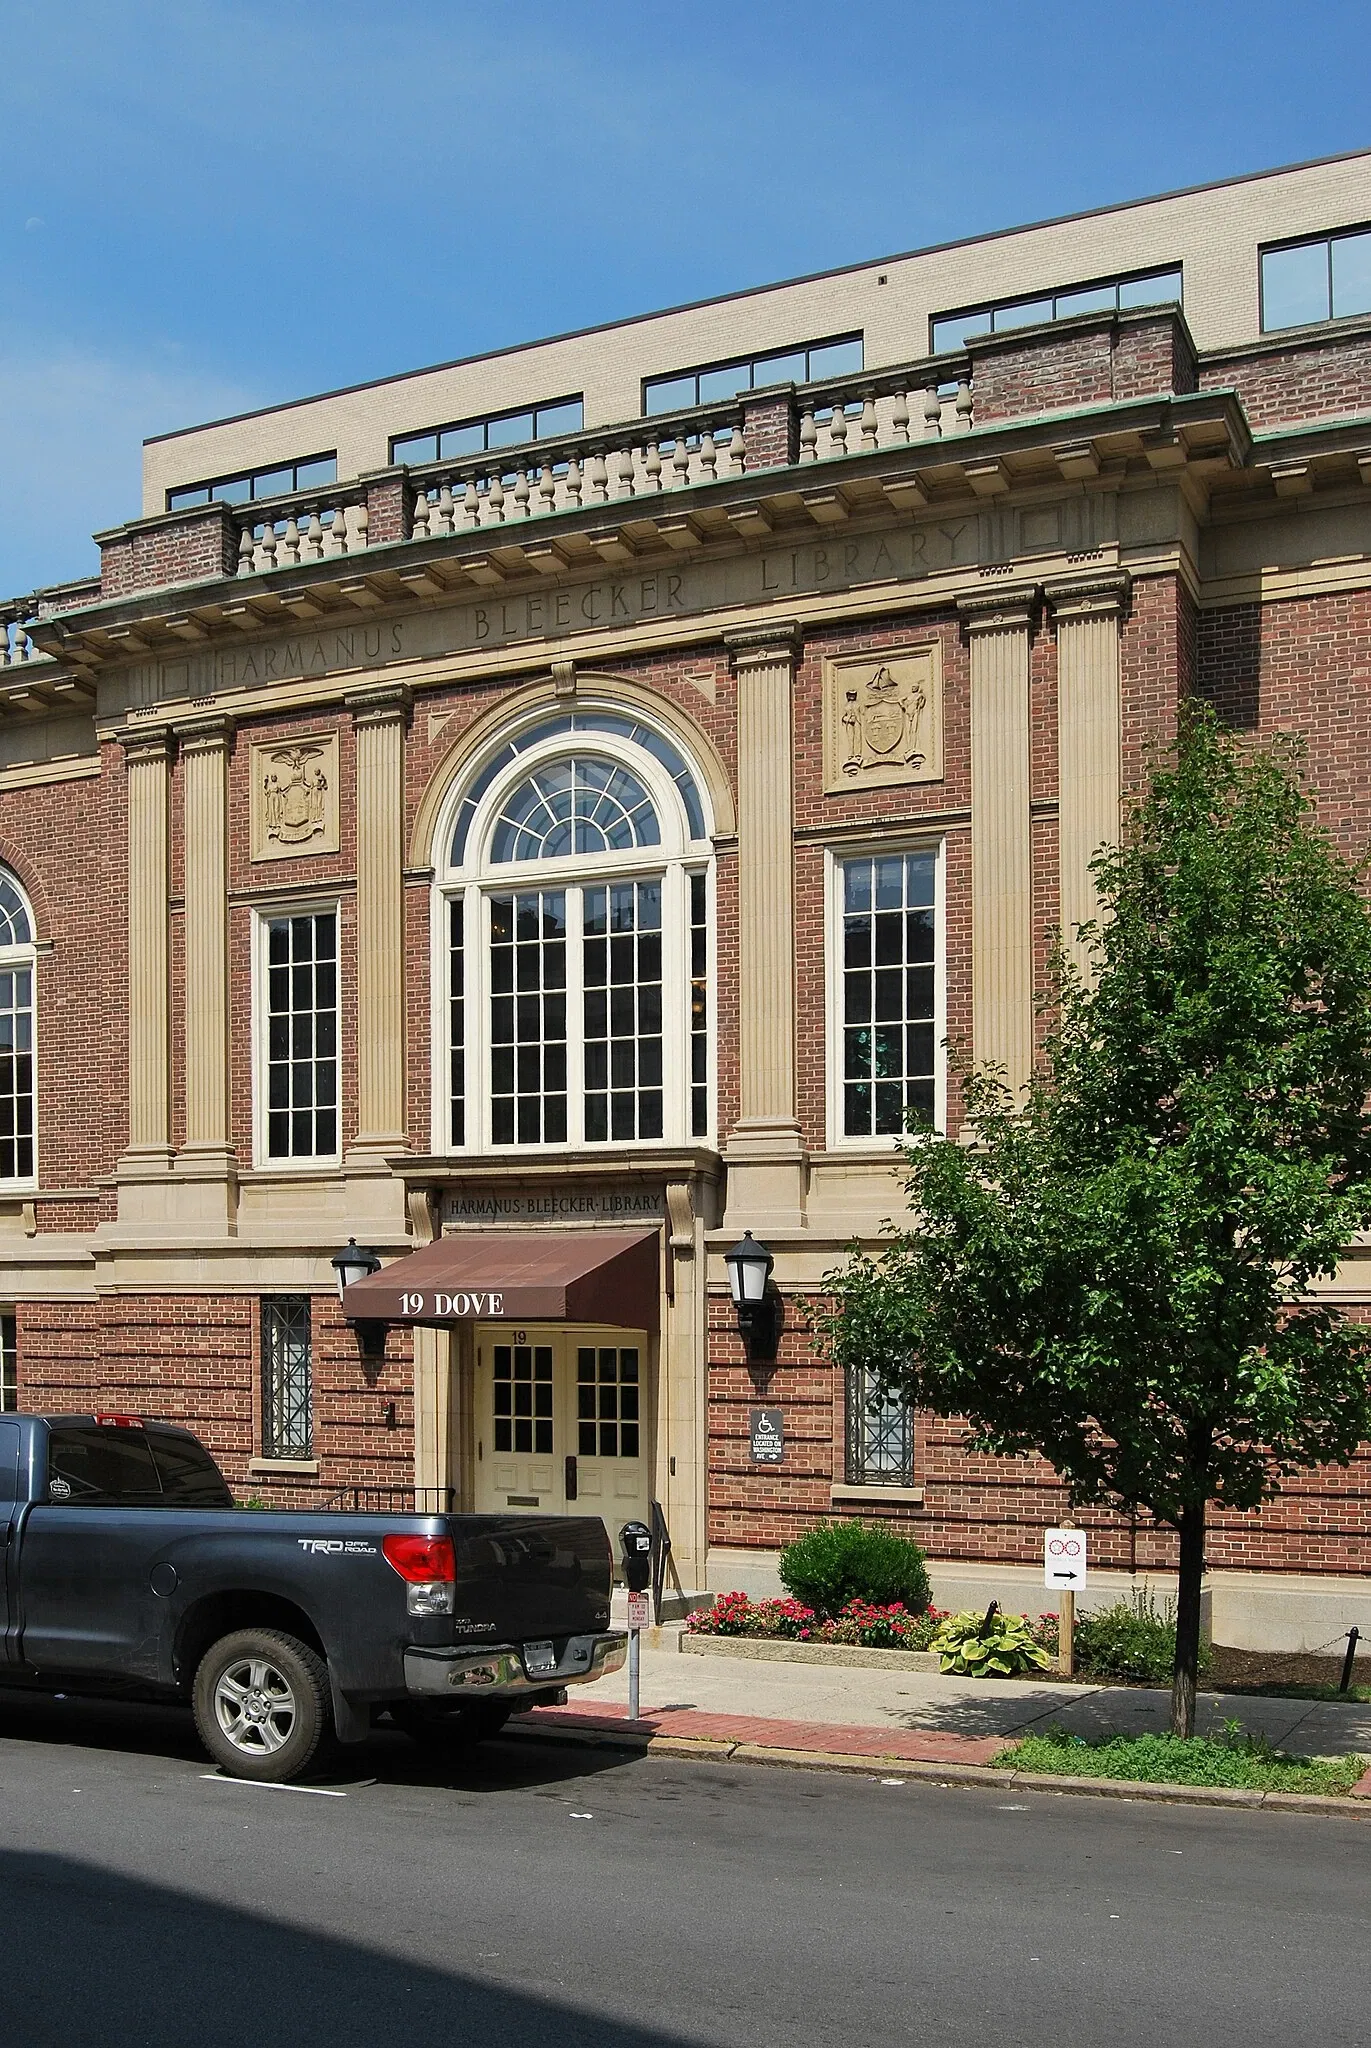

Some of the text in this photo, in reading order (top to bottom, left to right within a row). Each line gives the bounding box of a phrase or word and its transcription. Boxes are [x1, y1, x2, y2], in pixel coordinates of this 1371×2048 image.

[219, 523, 968, 684] HARMANUS BLEECKER LIBRARY
[451, 1194, 661, 1214] HARMANUS BLEECKER LIBRARY
[398, 1293, 504, 1316] 19 DOVE
[511, 1330, 527, 1345] 19
[297, 1539, 344, 1555] TRD
[455, 1622, 497, 1634] TUNDRA
